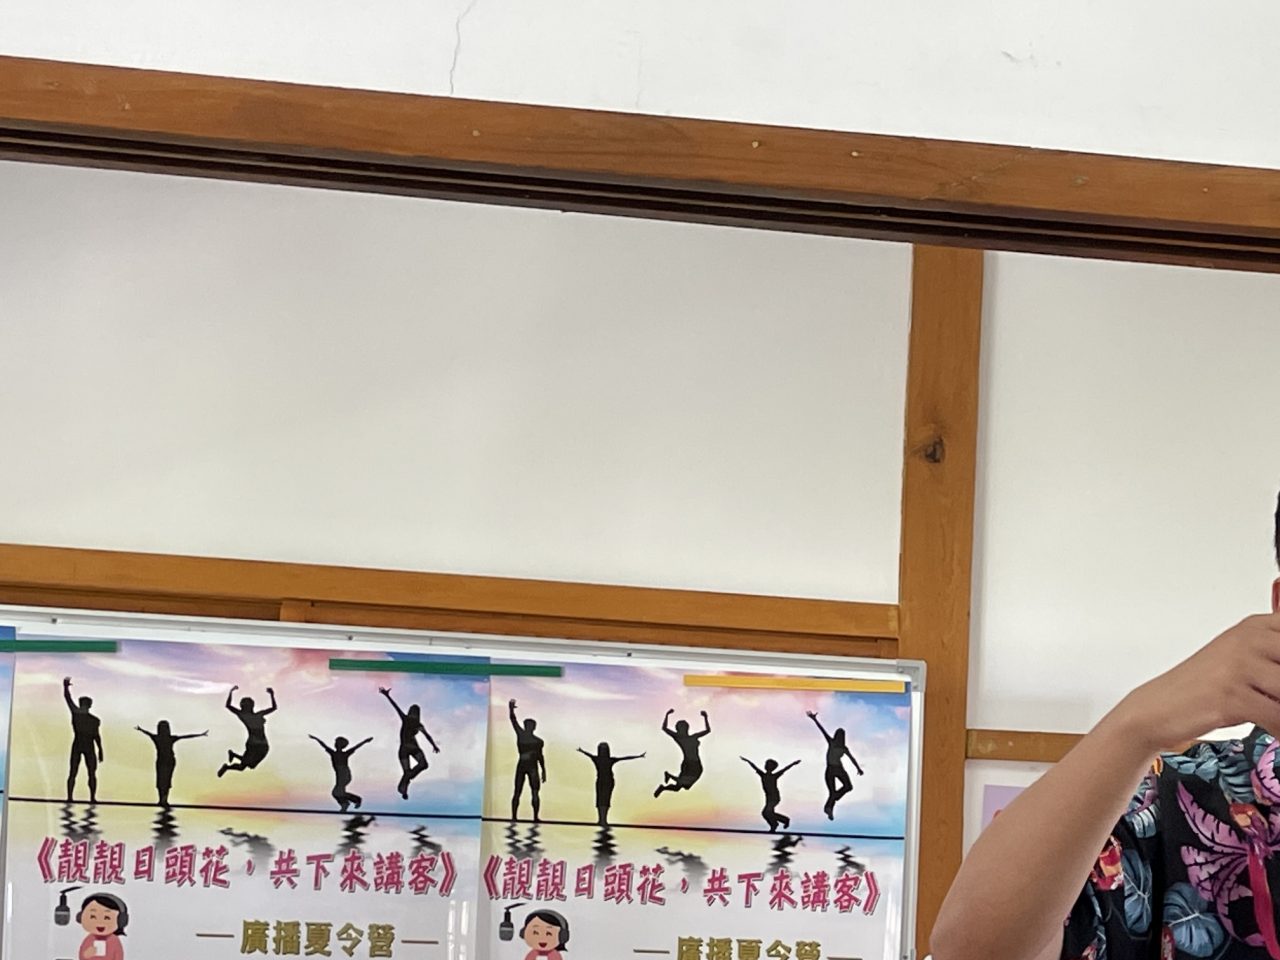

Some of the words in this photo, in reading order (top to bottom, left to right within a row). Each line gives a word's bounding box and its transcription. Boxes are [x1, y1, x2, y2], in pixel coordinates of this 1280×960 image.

[37, 836, 459, 897] 《靚靚日頭花，共下來講客》
[483, 854, 881, 914] 《靚靚日頭花，共下來講客》
[240, 919, 397, 958] 廣播夏令營
